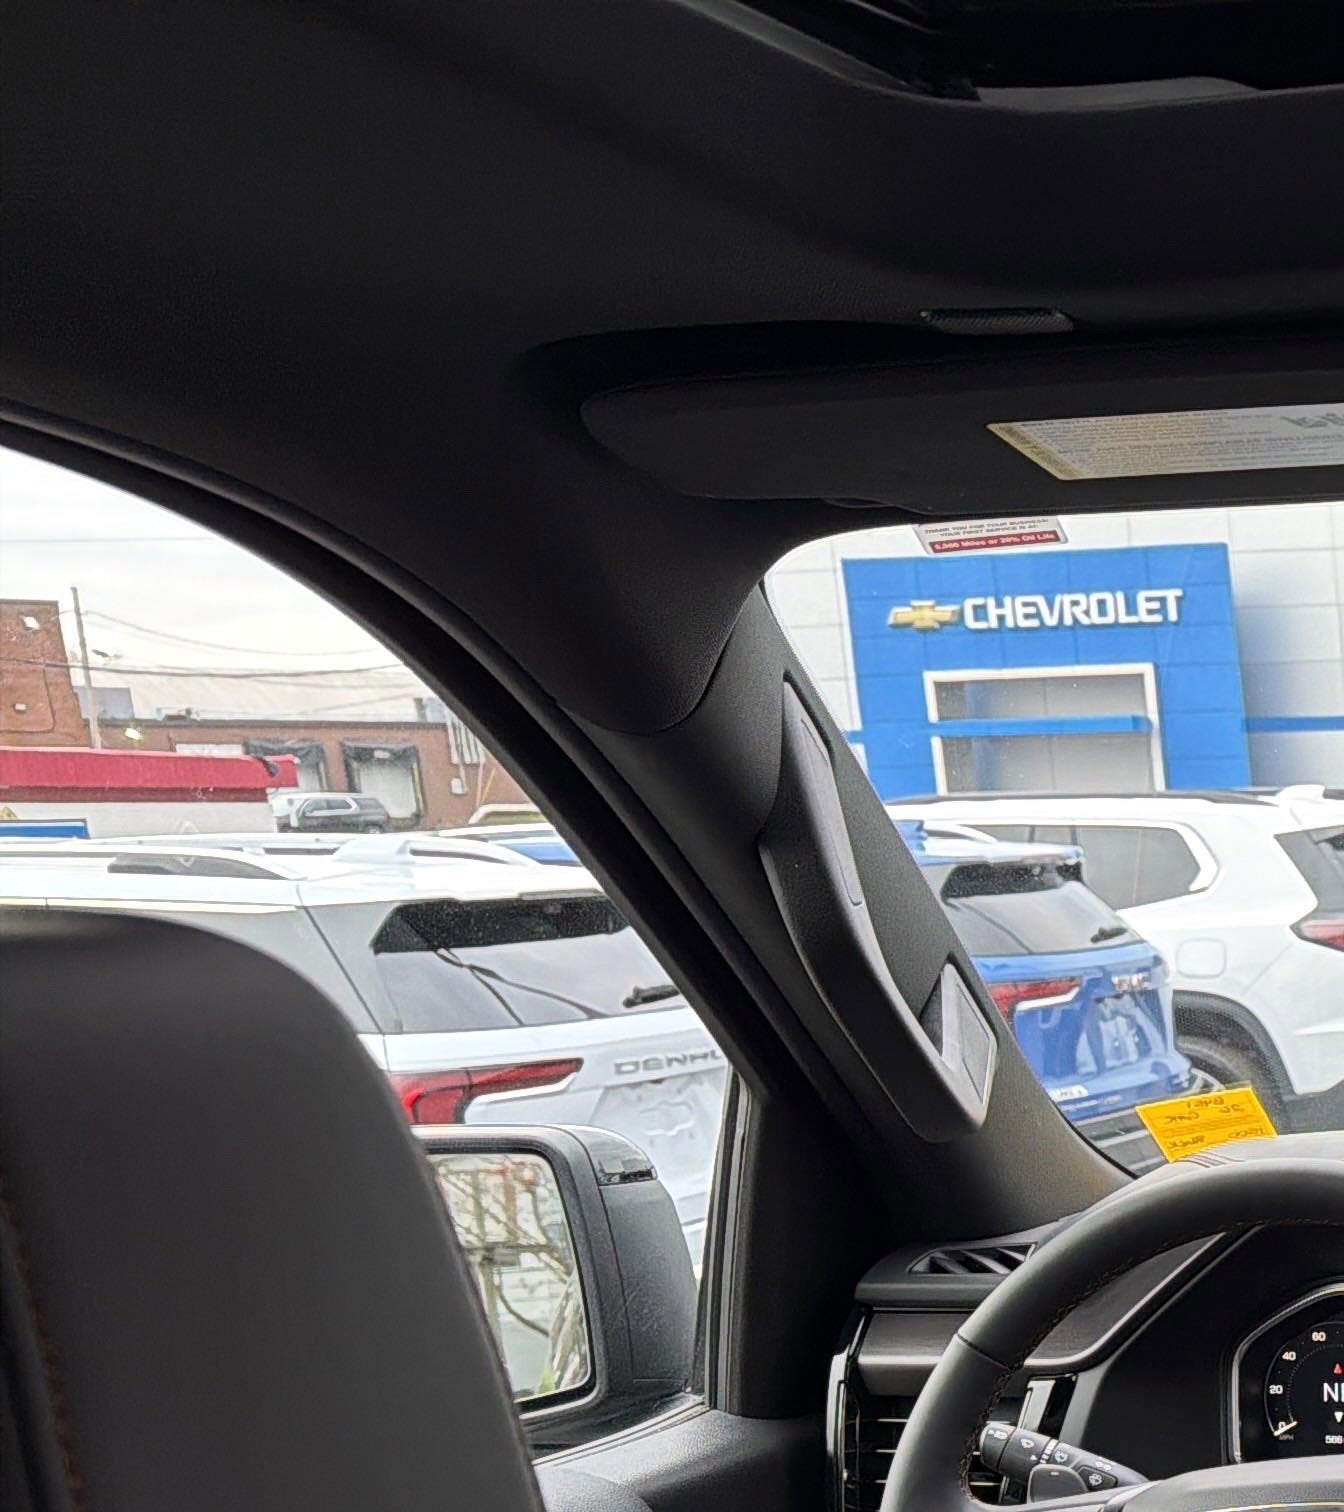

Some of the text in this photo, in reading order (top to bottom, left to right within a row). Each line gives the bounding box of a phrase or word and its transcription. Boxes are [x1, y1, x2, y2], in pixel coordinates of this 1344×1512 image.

[963, 588, 1183, 630] CHEVROLET
[1312, 1332, 1326, 1342] 60
[1282, 1352, 1296, 1361] 40
[1269, 1385, 1283, 1395] 20
